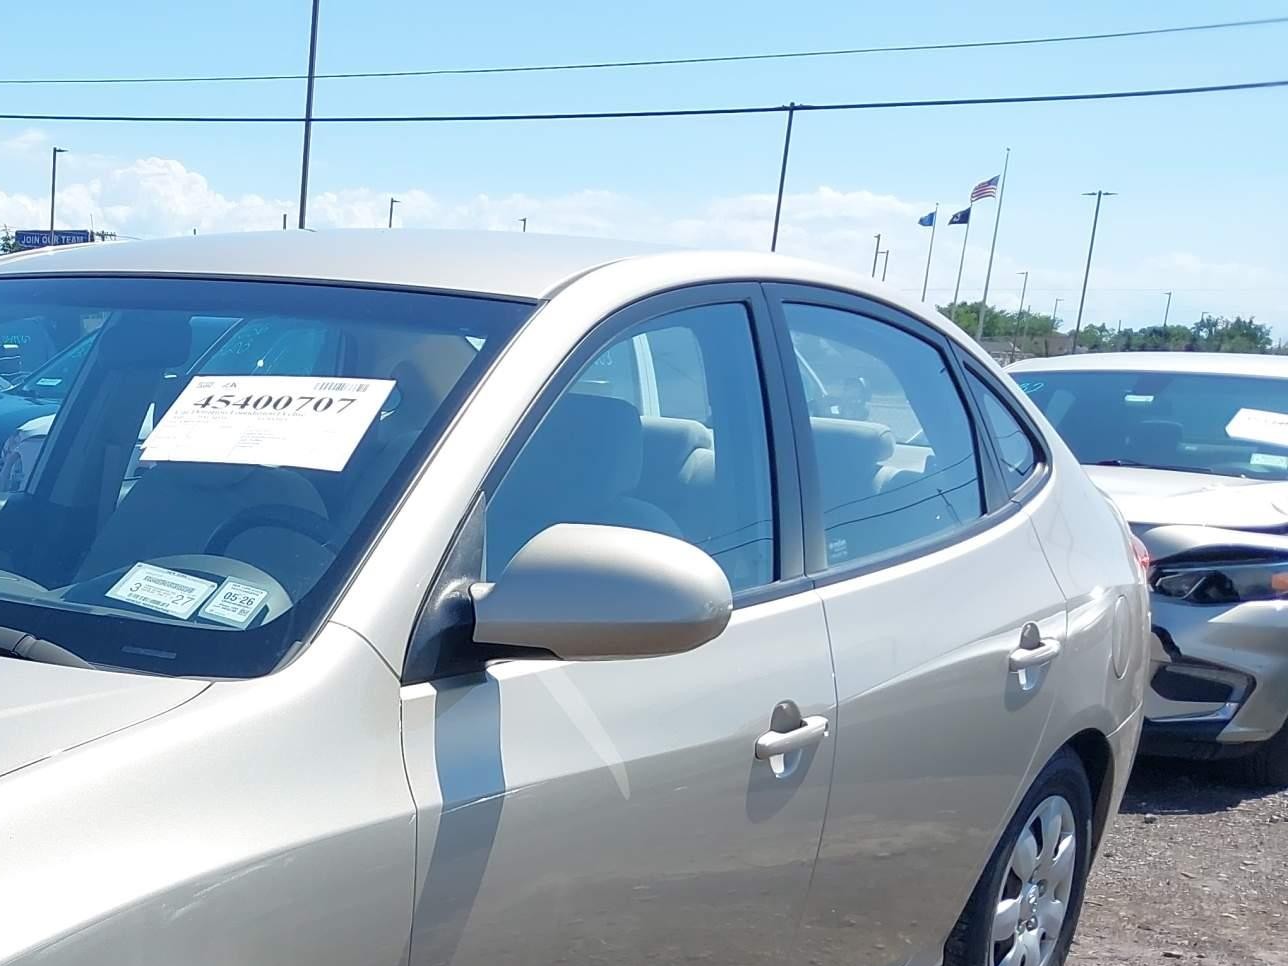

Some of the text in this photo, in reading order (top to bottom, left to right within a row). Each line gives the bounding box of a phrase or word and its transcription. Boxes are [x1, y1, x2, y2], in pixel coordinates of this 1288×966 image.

[21, 236, 40, 245] JOIN
[61, 236, 84, 244] TEAM
[193, 394, 358, 415] 45400707
